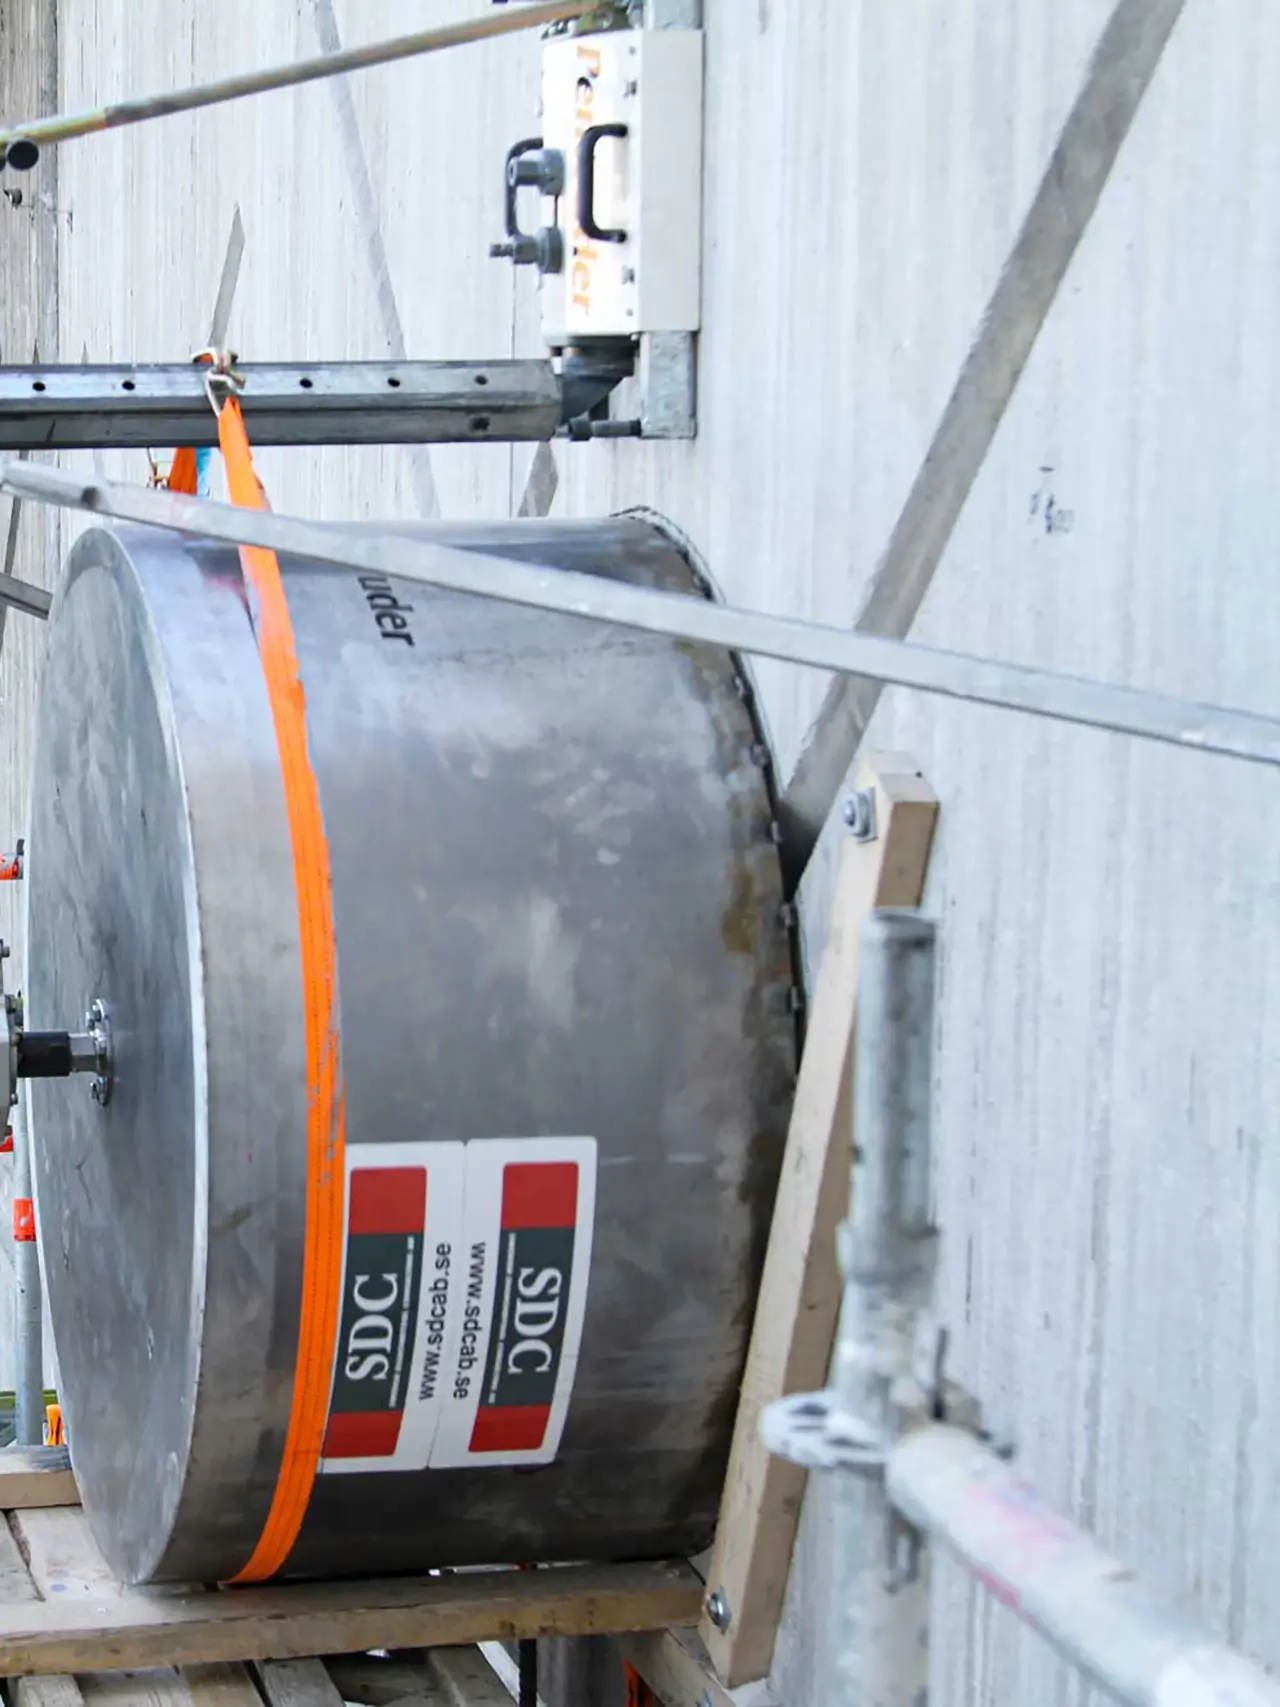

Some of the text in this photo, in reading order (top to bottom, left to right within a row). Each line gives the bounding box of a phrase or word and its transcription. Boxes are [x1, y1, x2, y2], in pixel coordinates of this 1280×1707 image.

[573, 45, 600, 317] Pender
[345, 1273, 399, 1381] SDC
[419, 1242, 452, 1402] www.sdcab.se
[453, 1242, 486, 1400] www.sdcab.se
[508, 1267, 563, 1374] SDC
